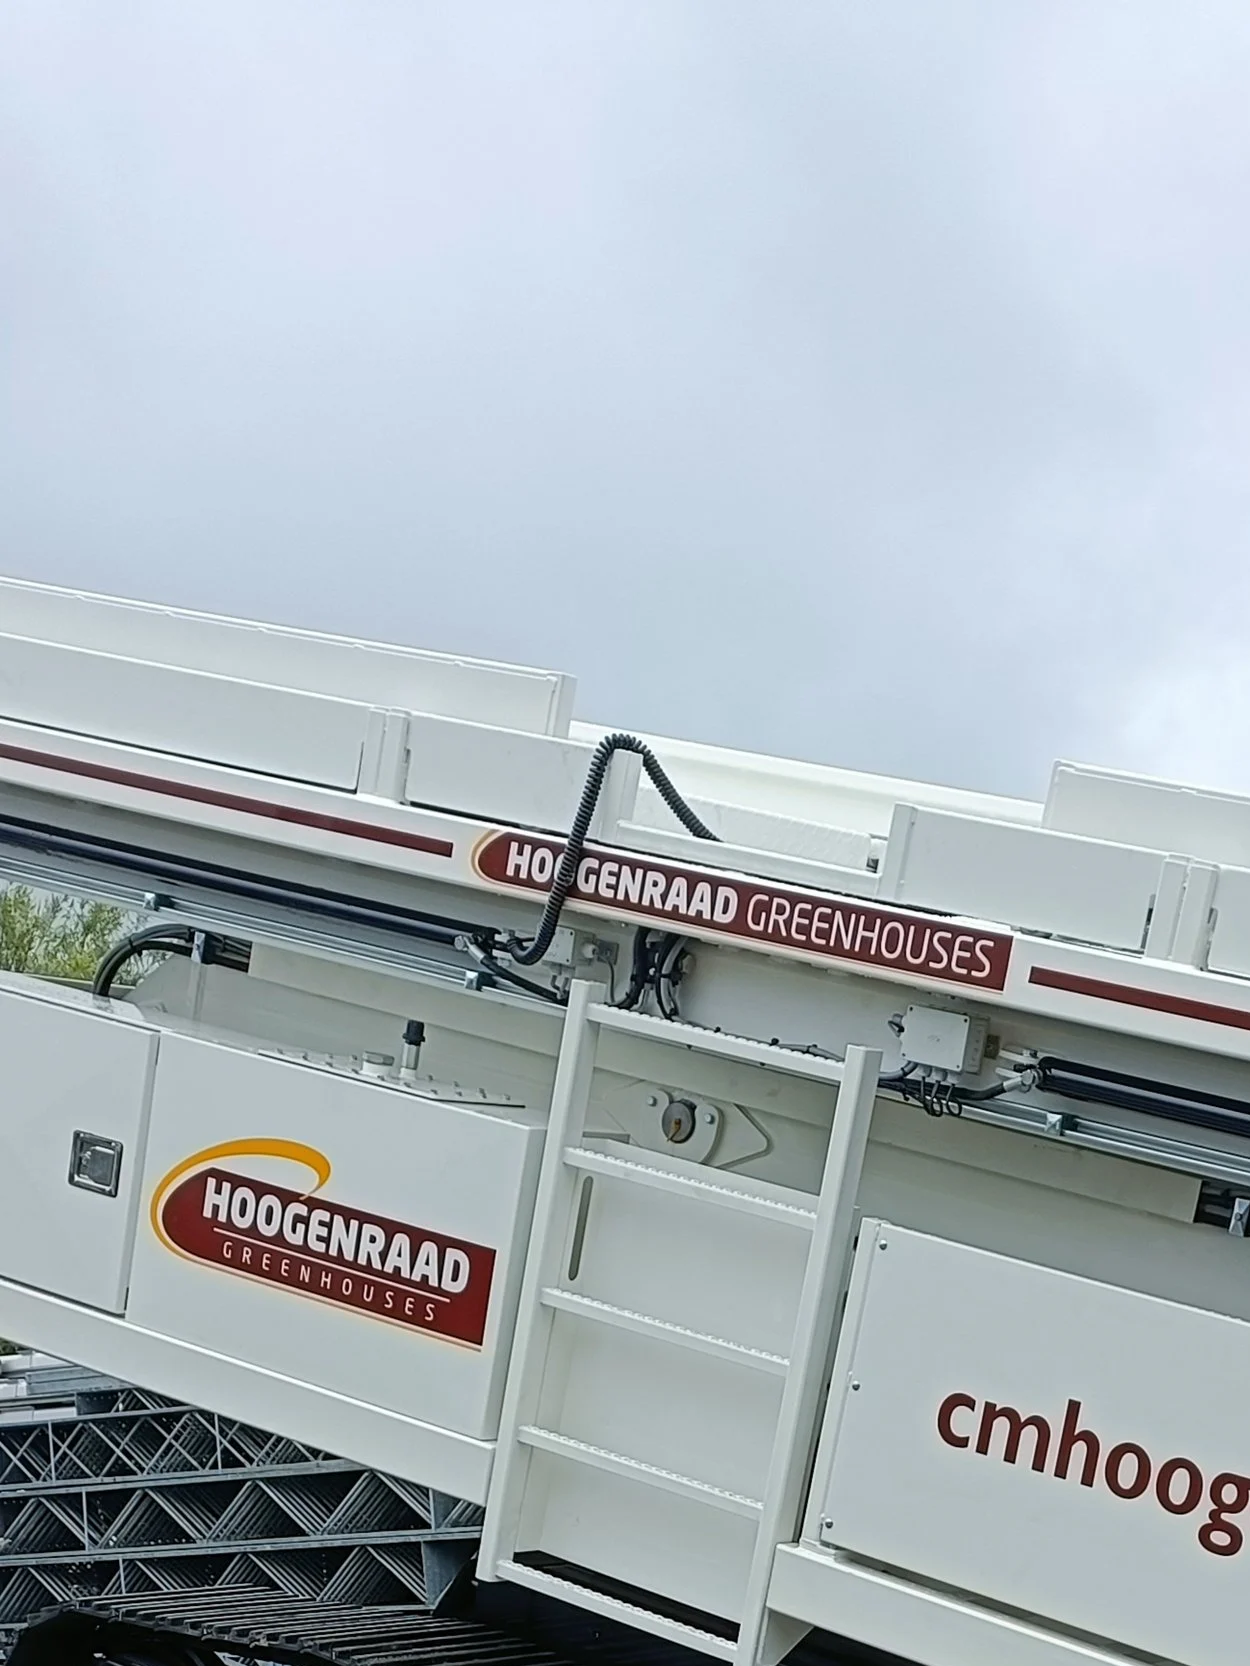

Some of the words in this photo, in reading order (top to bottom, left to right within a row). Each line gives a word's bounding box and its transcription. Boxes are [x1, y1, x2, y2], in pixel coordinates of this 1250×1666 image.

[746, 893, 995, 978] GREENHOUSES
[203, 1176, 470, 1293] HOOGENRAAD
[223, 1241, 435, 1321] GREENHOUSES
